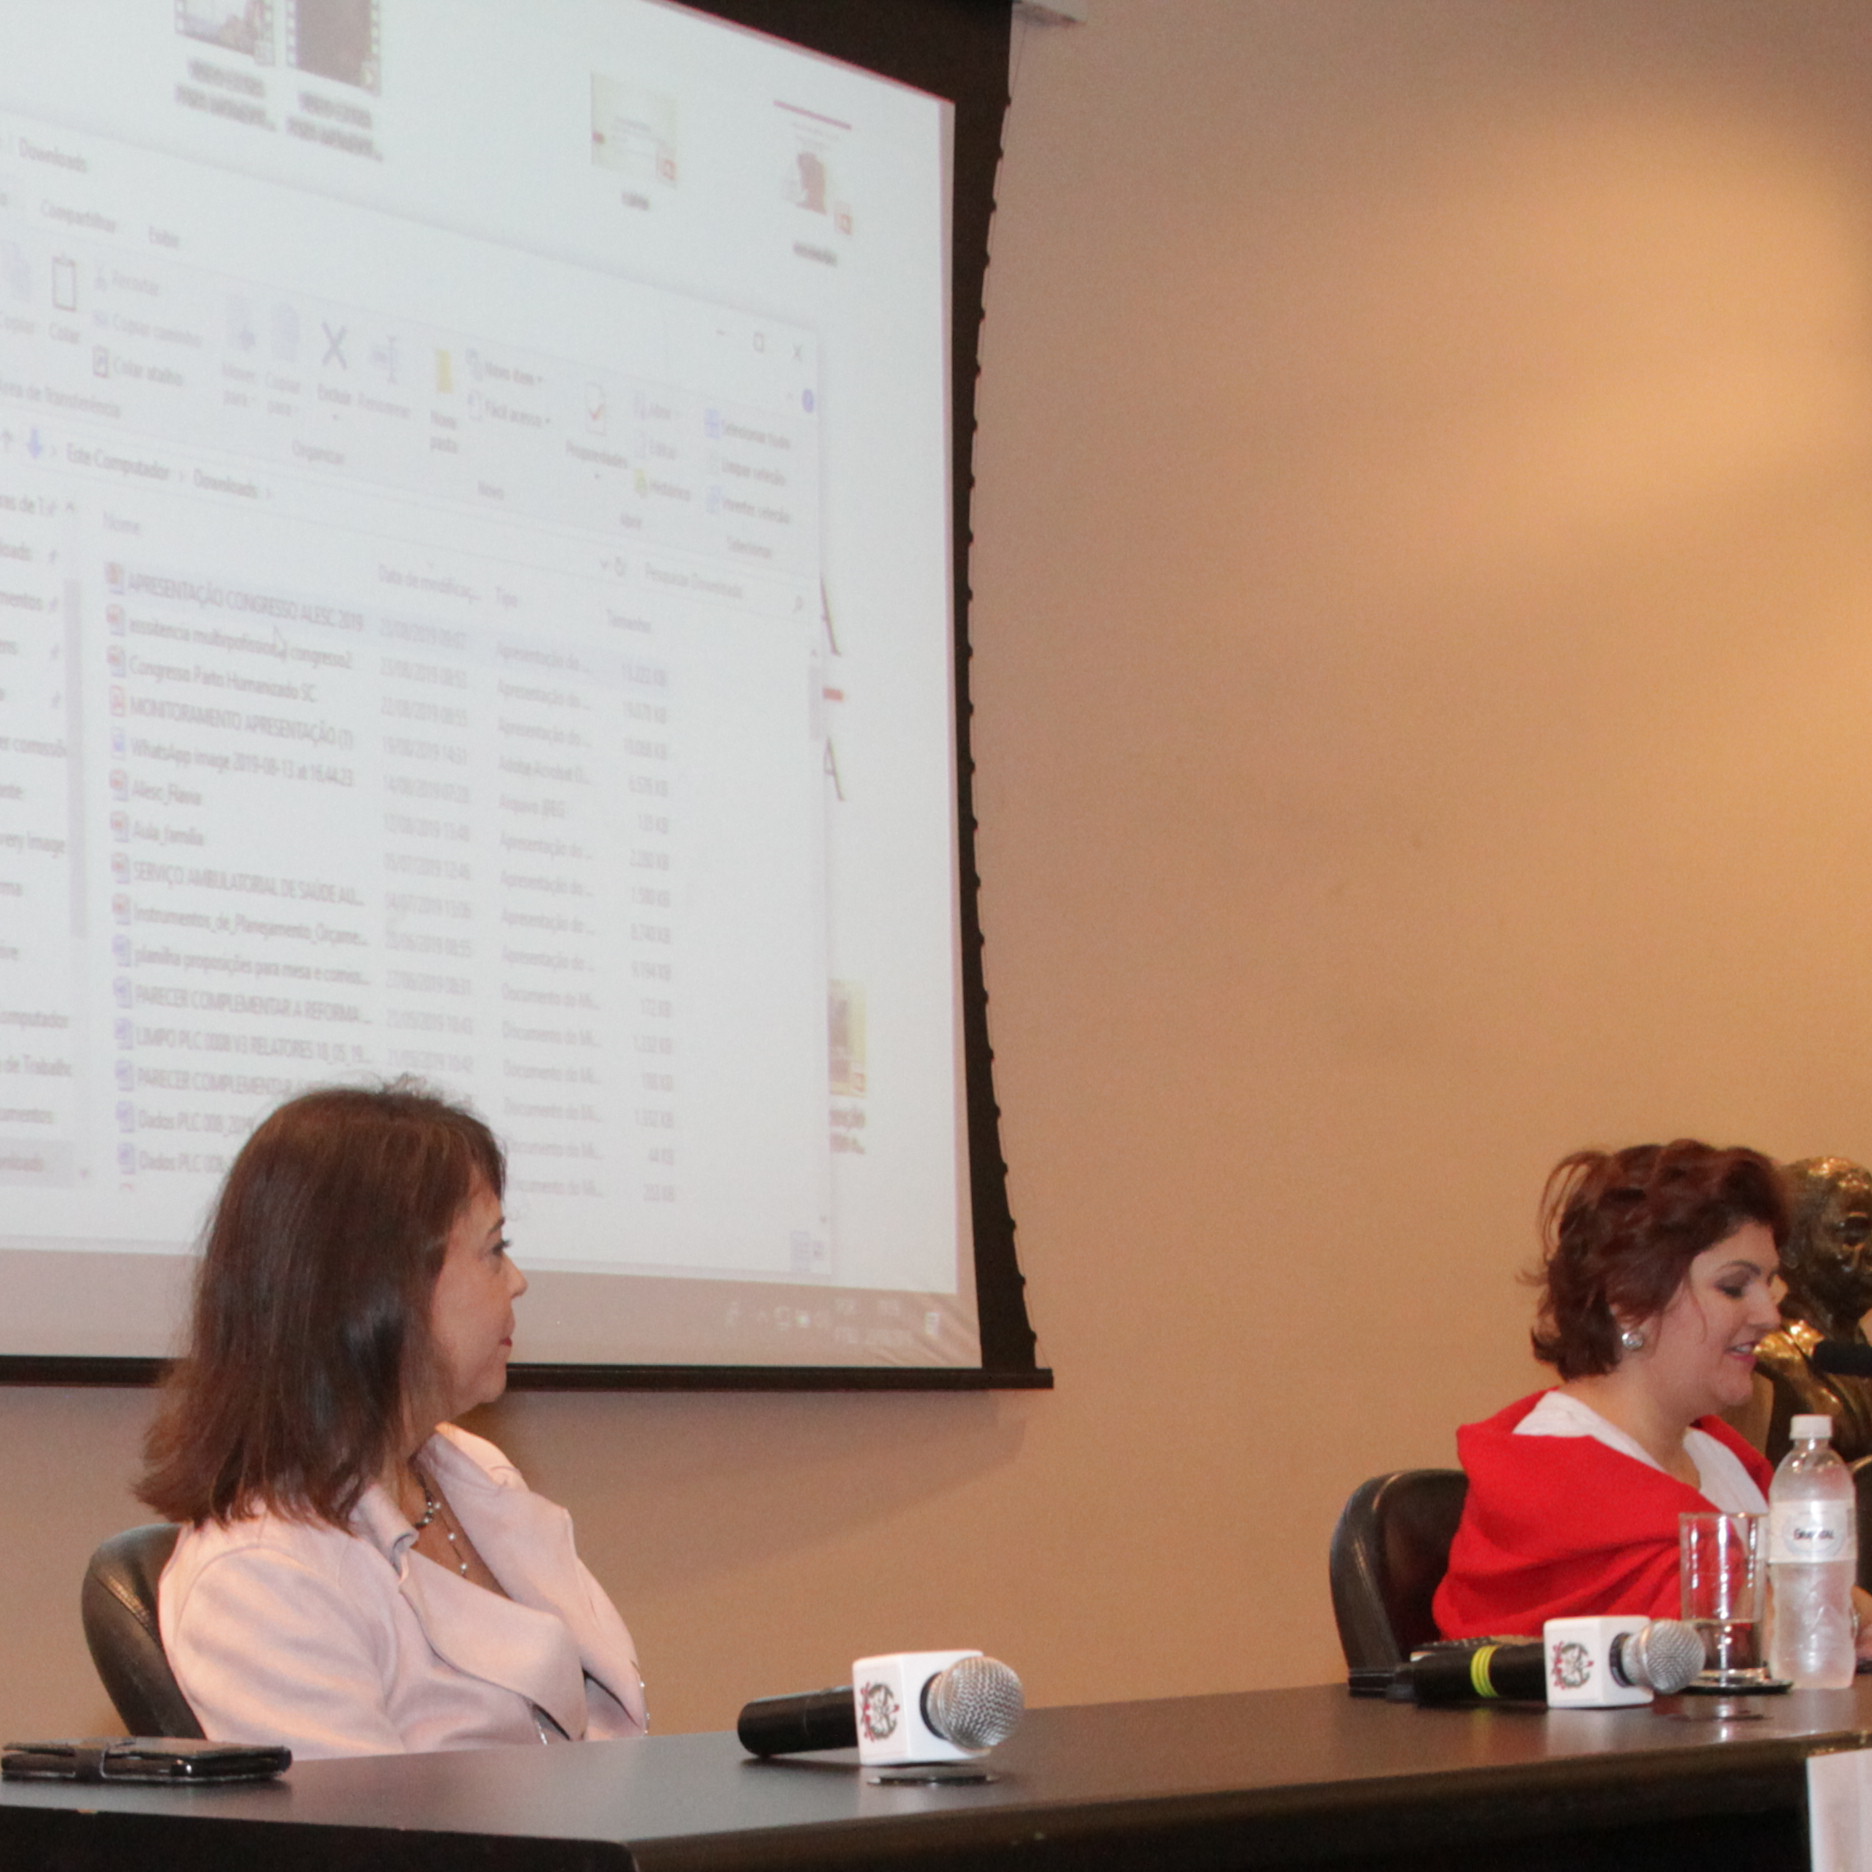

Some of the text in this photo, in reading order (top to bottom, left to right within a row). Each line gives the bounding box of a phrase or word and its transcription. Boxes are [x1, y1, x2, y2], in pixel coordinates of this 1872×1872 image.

[94, 448, 169, 485] Computador
[194, 467, 258, 499] Downloads
[128, 568, 222, 611] APRESENTAÇÃO
[226, 590, 297, 621] CONGRESSO
[129, 654, 190, 688] Congresso
[193, 664, 223, 688] Parto
[226, 669, 298, 699] Humanizado
[130, 695, 241, 731] MONITORAMENTO
[245, 708, 335, 748] APRESENTAÇÃO
[134, 860, 184, 891] SERVIÇO
[136, 984, 188, 1008] PARECER
[191, 989, 290, 1017] COMPLEMENTAR
